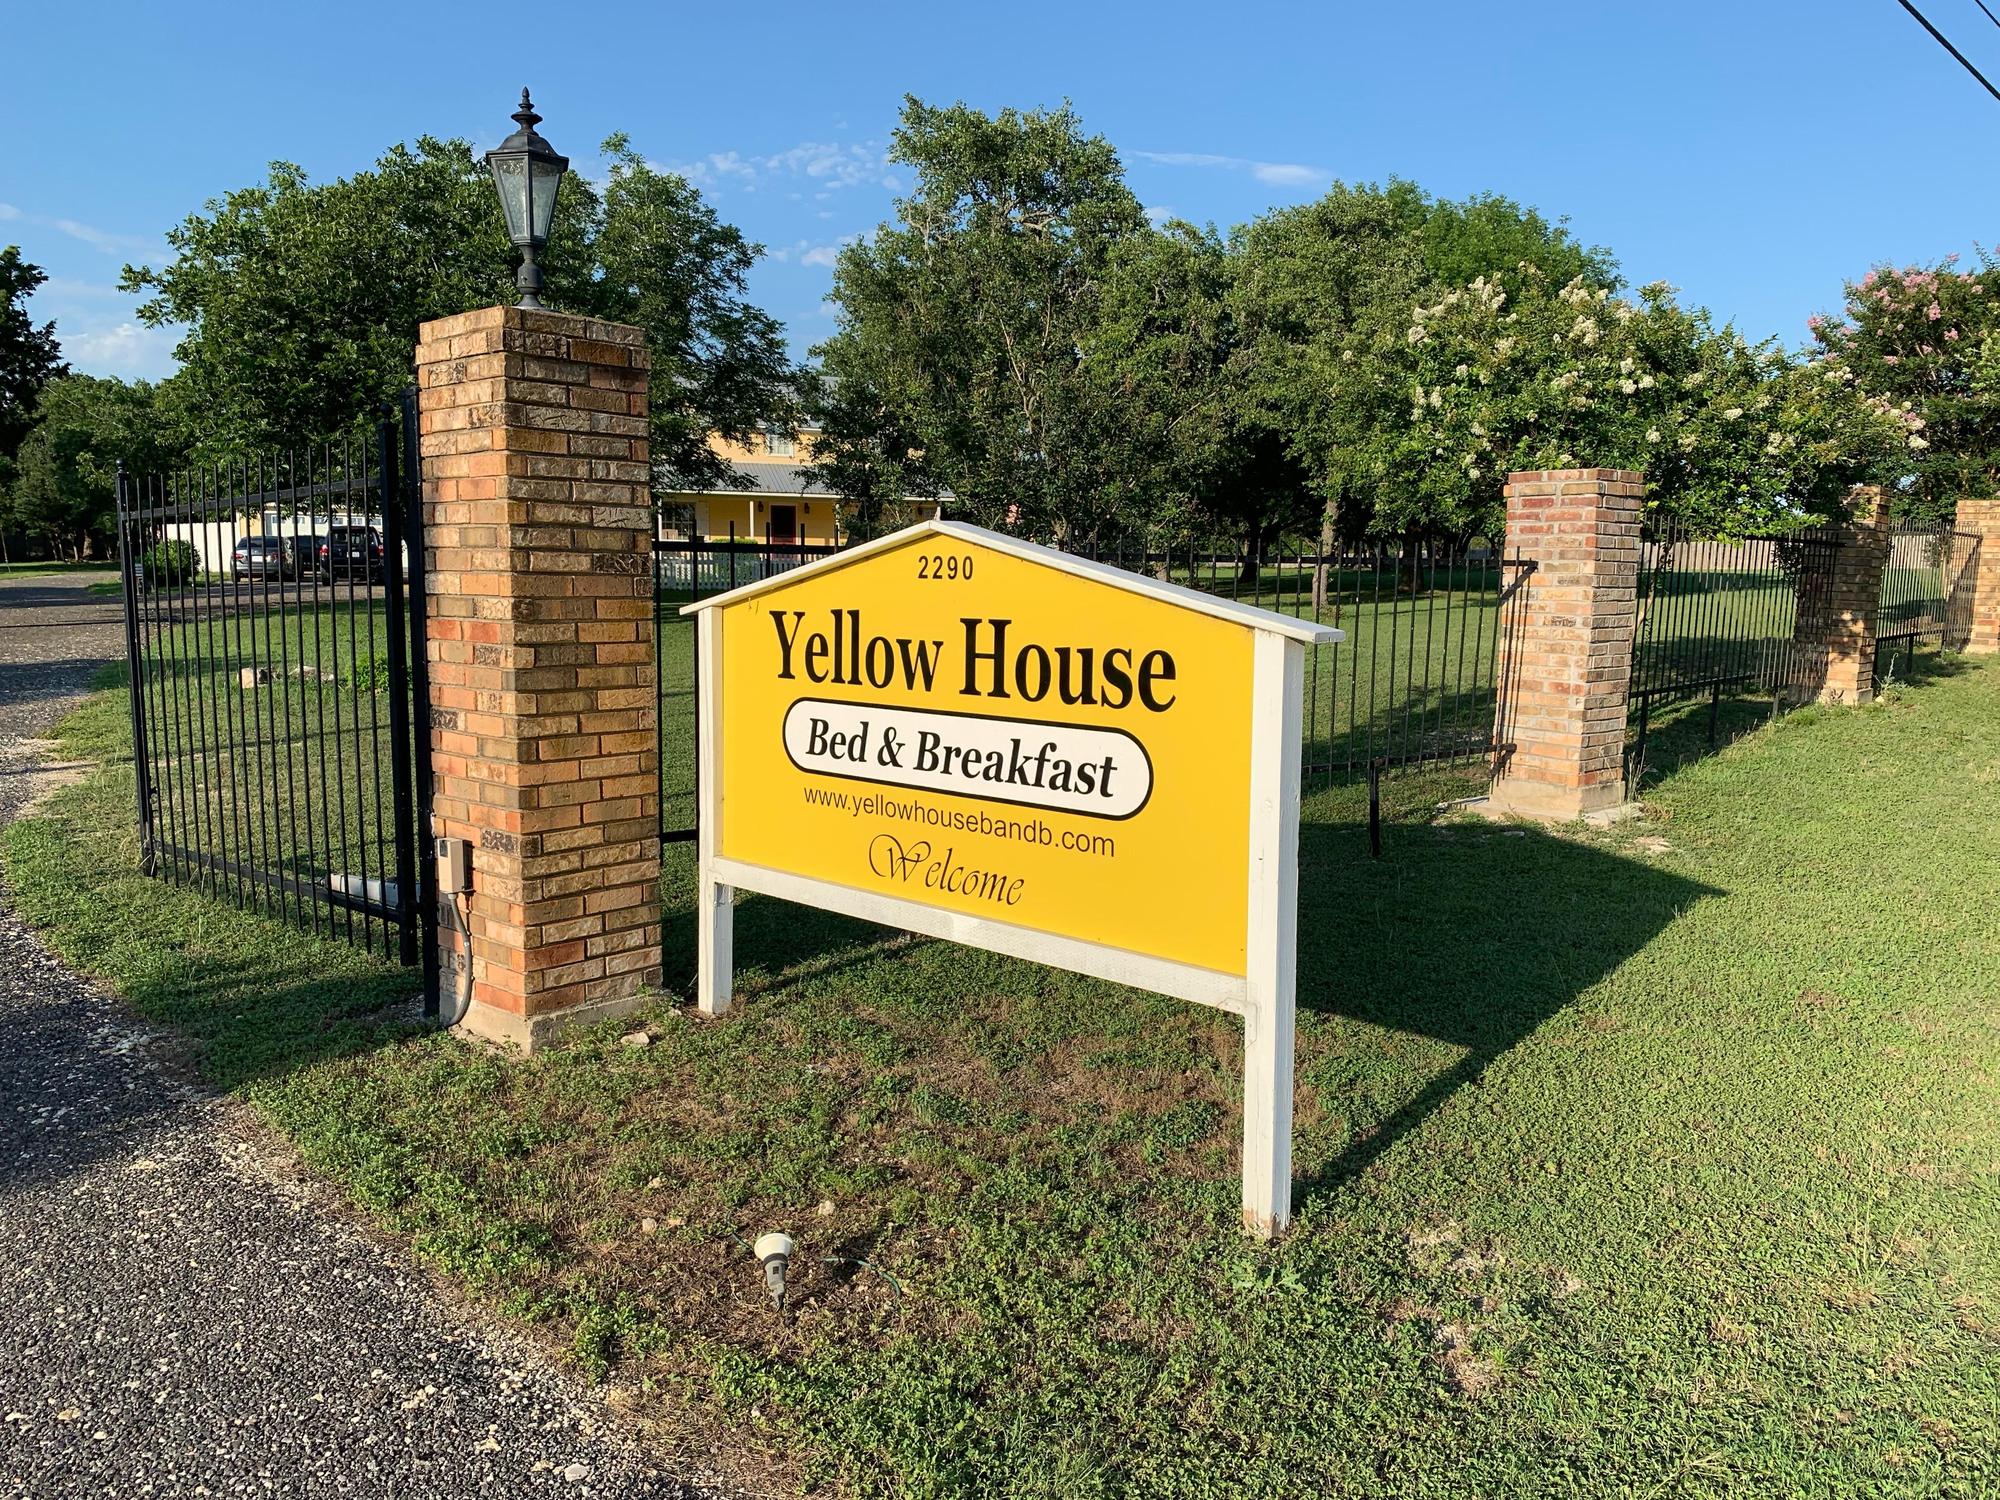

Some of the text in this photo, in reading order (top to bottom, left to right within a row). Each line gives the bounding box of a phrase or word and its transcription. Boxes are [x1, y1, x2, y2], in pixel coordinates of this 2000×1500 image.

[918, 555, 973, 580] 2290
[769, 609, 1177, 713] Yellow House
[805, 717, 1118, 798] Bed & Breakfast
[803, 785, 1115, 858] www.yellowhousebandb.com
[869, 833, 1025, 907] Welcome
